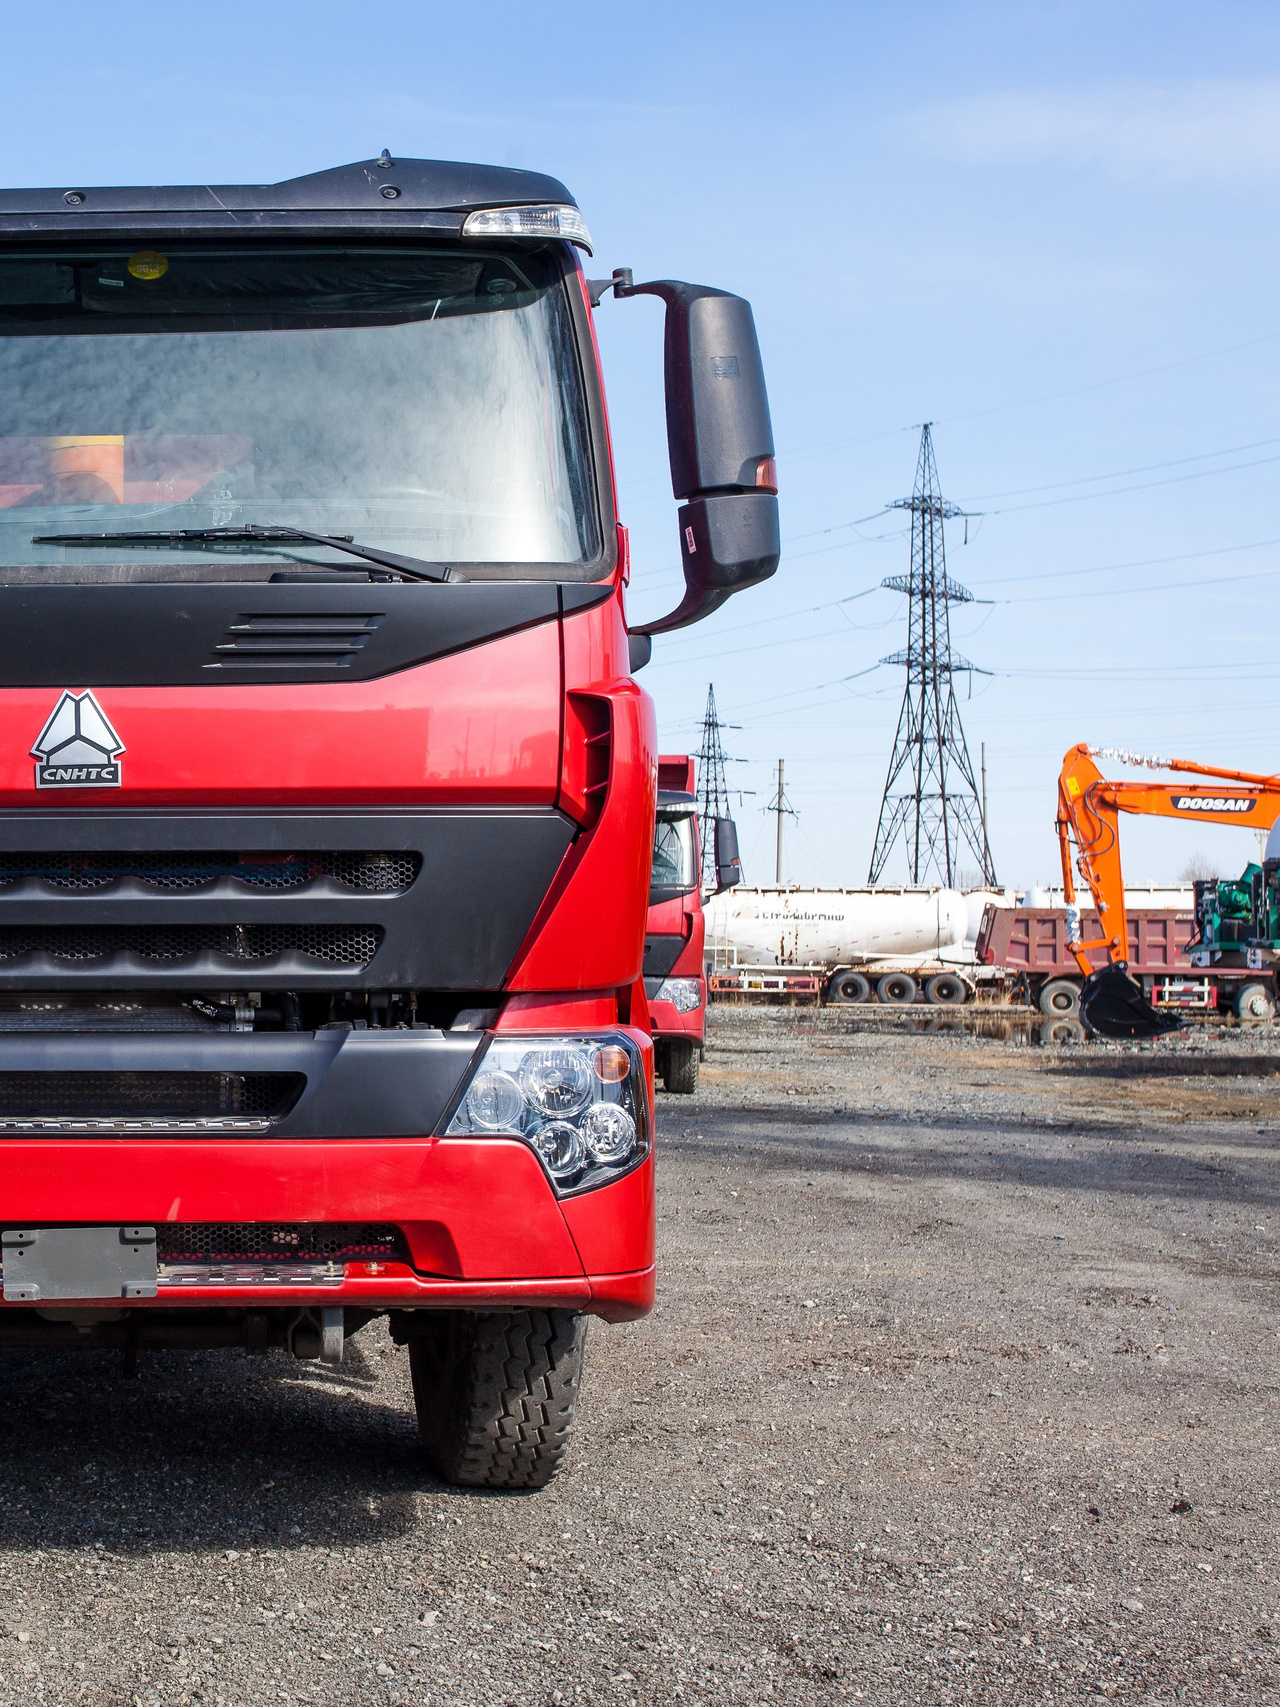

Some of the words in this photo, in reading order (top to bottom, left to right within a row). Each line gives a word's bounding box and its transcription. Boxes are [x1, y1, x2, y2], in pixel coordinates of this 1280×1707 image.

[137, 264, 160, 273] 2013
[42, 767, 115, 781] CNHTC
[1177, 797, 1250, 811] DOOSAN
